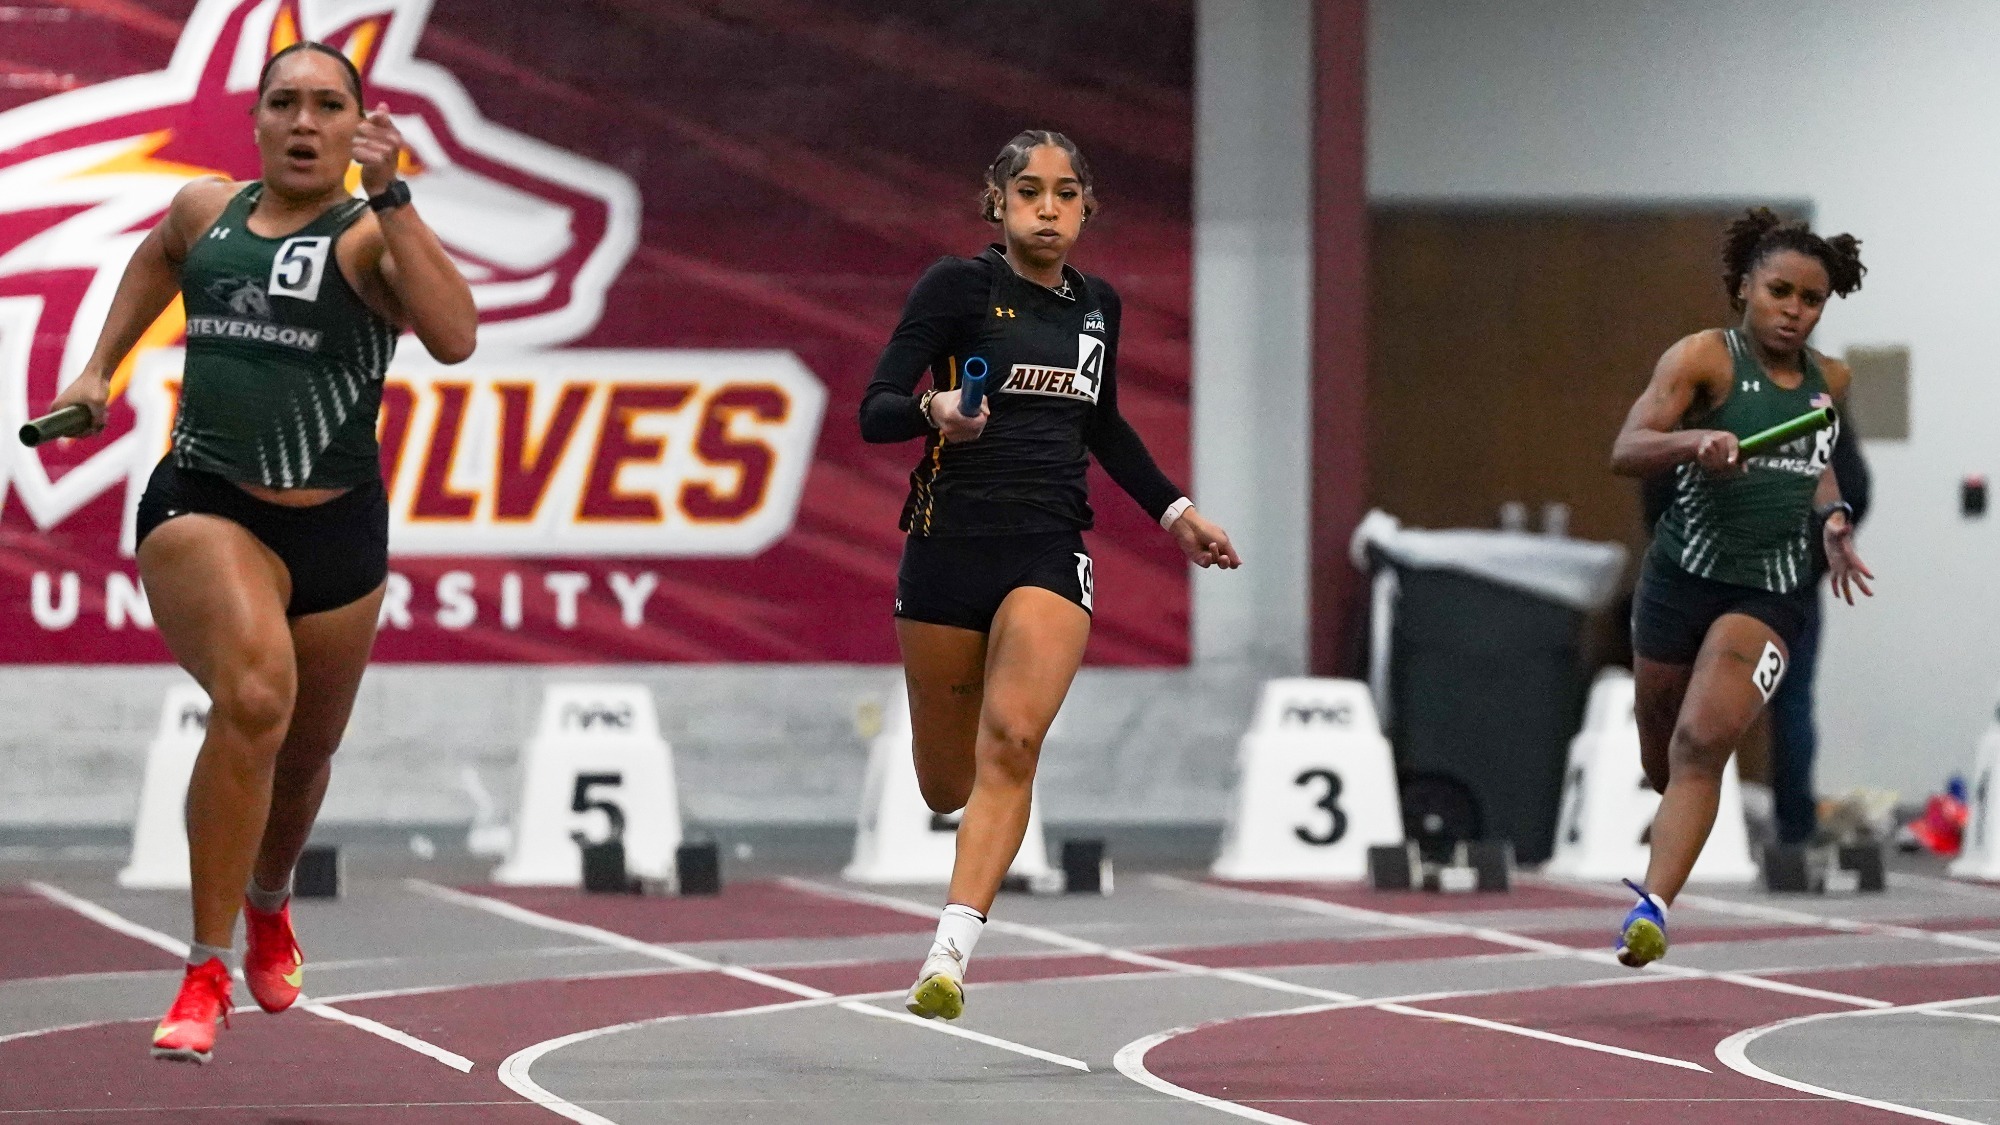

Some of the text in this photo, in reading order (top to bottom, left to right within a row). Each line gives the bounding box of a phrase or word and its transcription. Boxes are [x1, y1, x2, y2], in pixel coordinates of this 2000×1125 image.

[277, 240, 318, 291] 5
[1006, 367, 1092, 397] ALVER
[1080, 343, 1103, 394] 4
[30, 570, 660, 631] UNRSITY
[1760, 651, 1780, 693] 3
[570, 773, 626, 846] 5
[1294, 768, 1349, 847] 3
